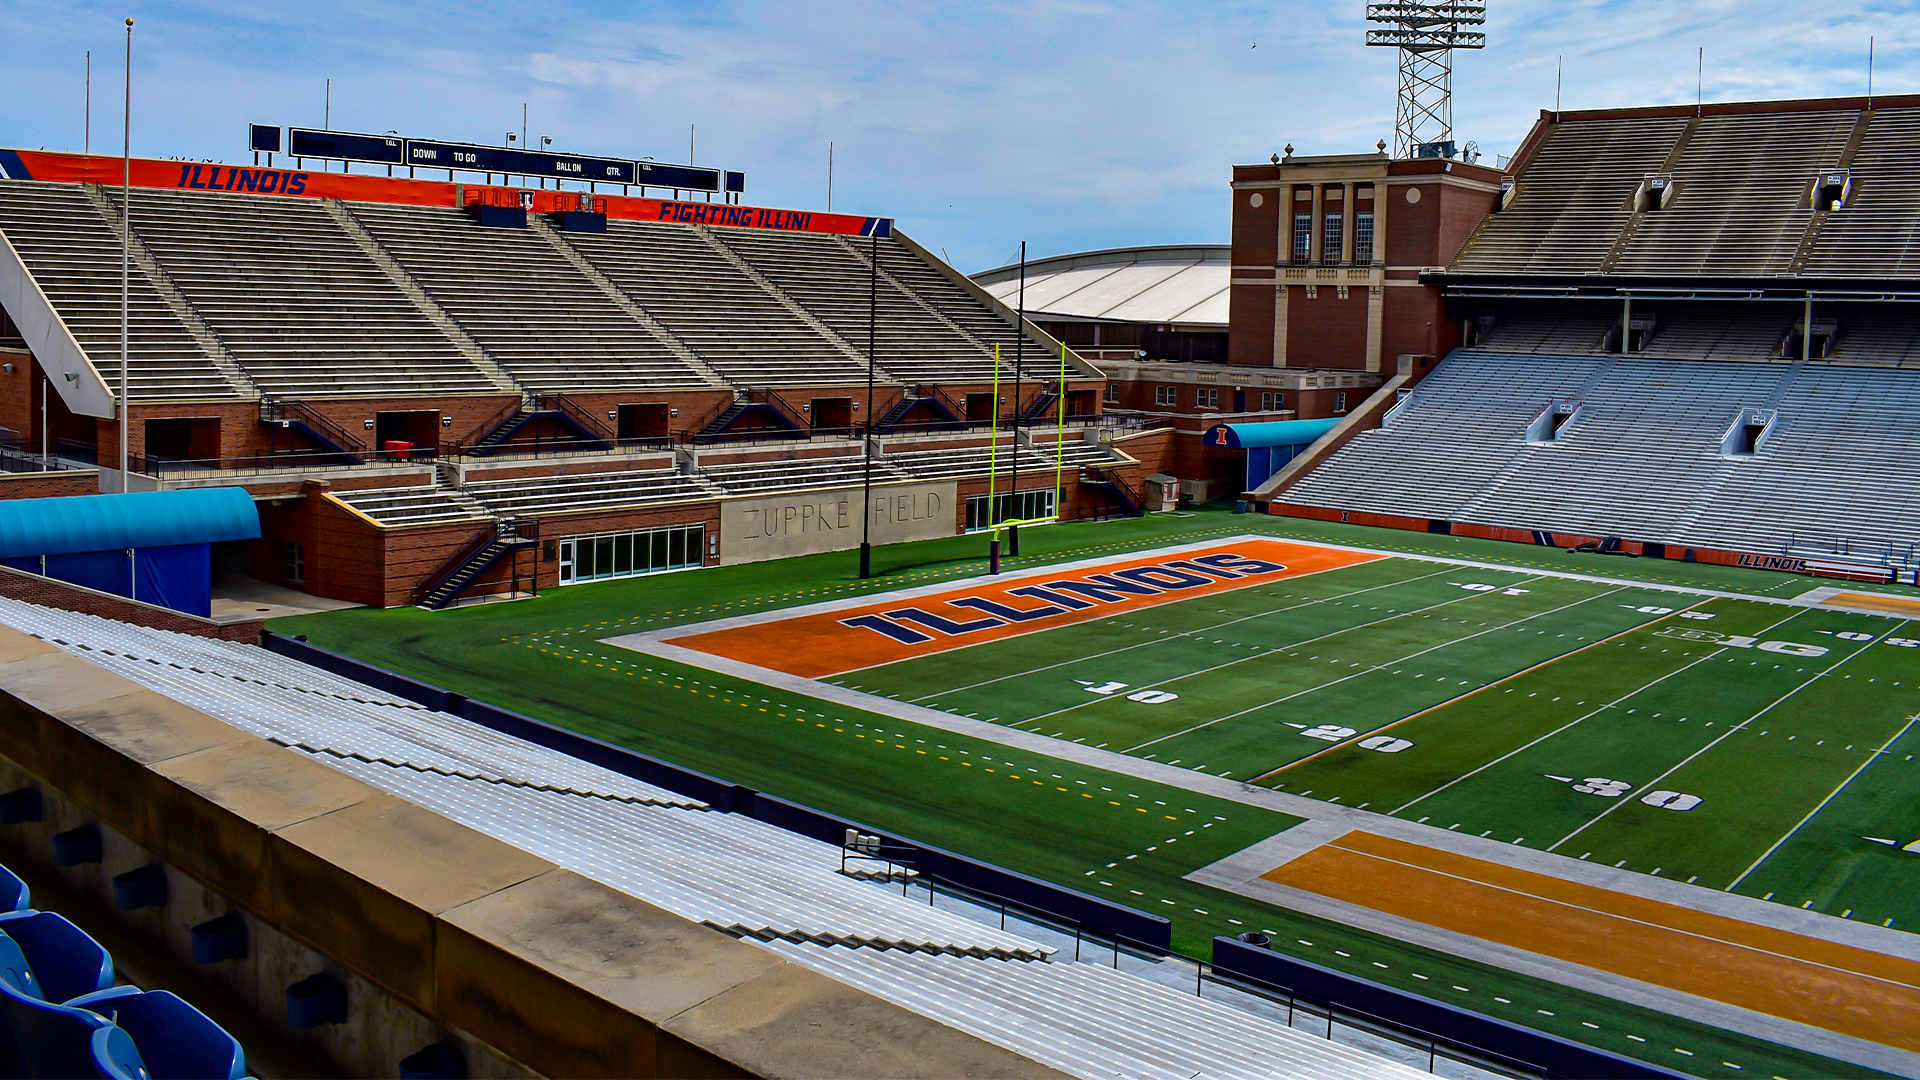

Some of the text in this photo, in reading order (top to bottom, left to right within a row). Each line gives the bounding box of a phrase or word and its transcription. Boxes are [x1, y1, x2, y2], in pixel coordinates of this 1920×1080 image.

[413, 148, 437, 160] DOWN
[453, 151, 477, 163] TO GO
[556, 161, 582, 173] BALL ON
[606, 166, 622, 177] QTR.
[178, 164, 309, 196] ILLINOIS
[658, 201, 812, 231] FIGHTING ILLINI
[1216, 427, 1228, 445] I
[742, 492, 942, 540] ZUPPKE FIELD
[1737, 553, 1807, 572] ILLINOIS
[836, 553, 1288, 646] ILLINOIS
[1083, 680, 1180, 705] 10
[1298, 723, 1416, 753] 20
[1571, 776, 1705, 812] 30
